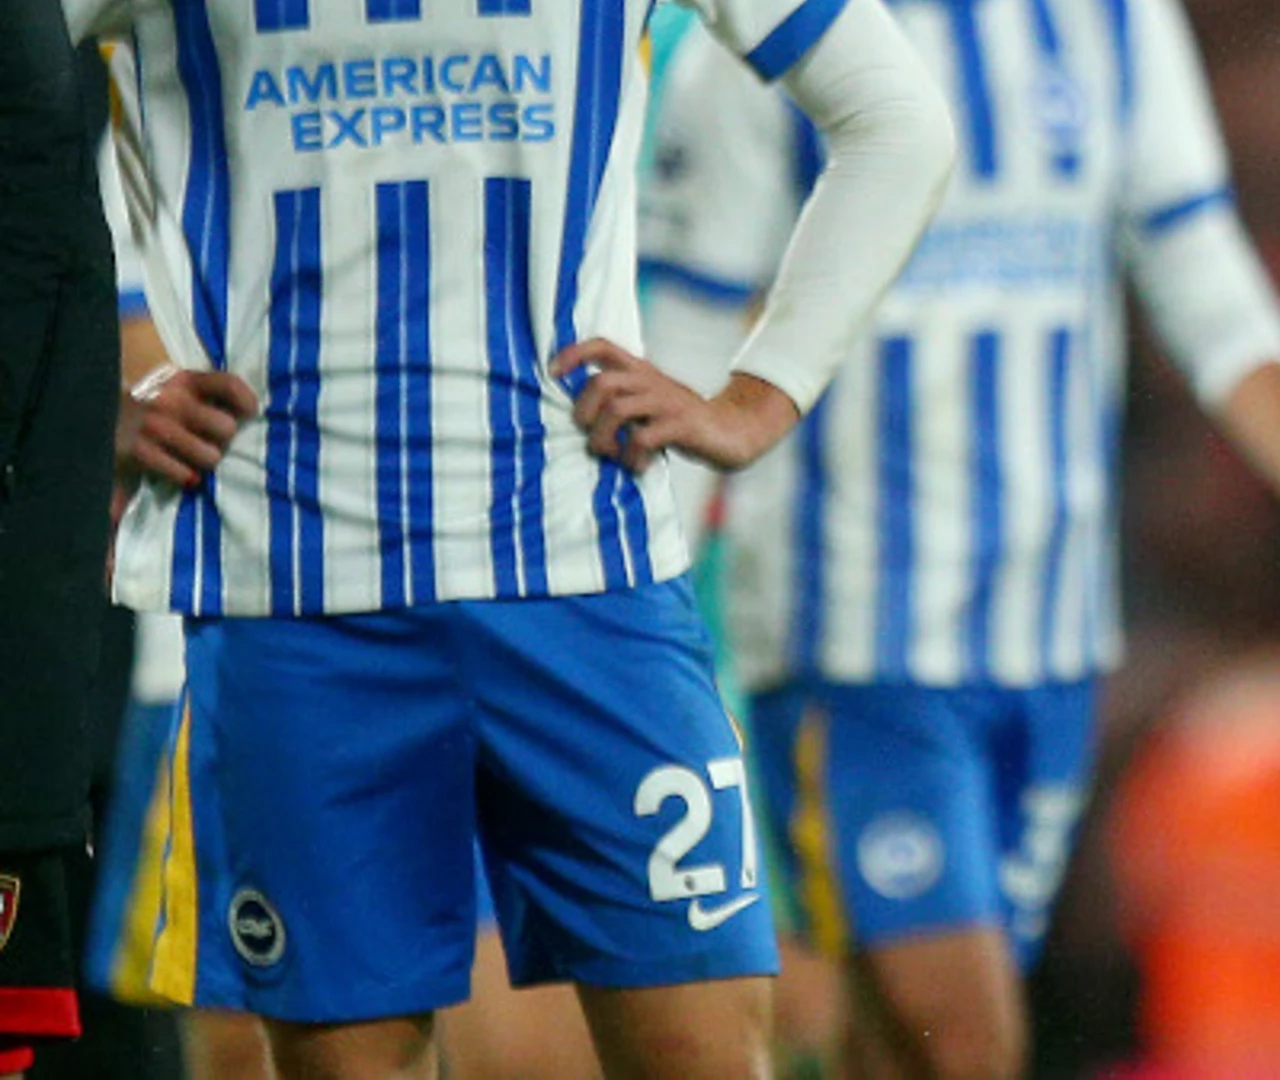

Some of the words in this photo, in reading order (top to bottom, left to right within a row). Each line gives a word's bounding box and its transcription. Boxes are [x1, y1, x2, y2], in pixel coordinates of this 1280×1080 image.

[245, 54, 552, 110] AMERICAN
[290, 103, 556, 152] EXPRESS
[633, 758, 757, 902] 27
